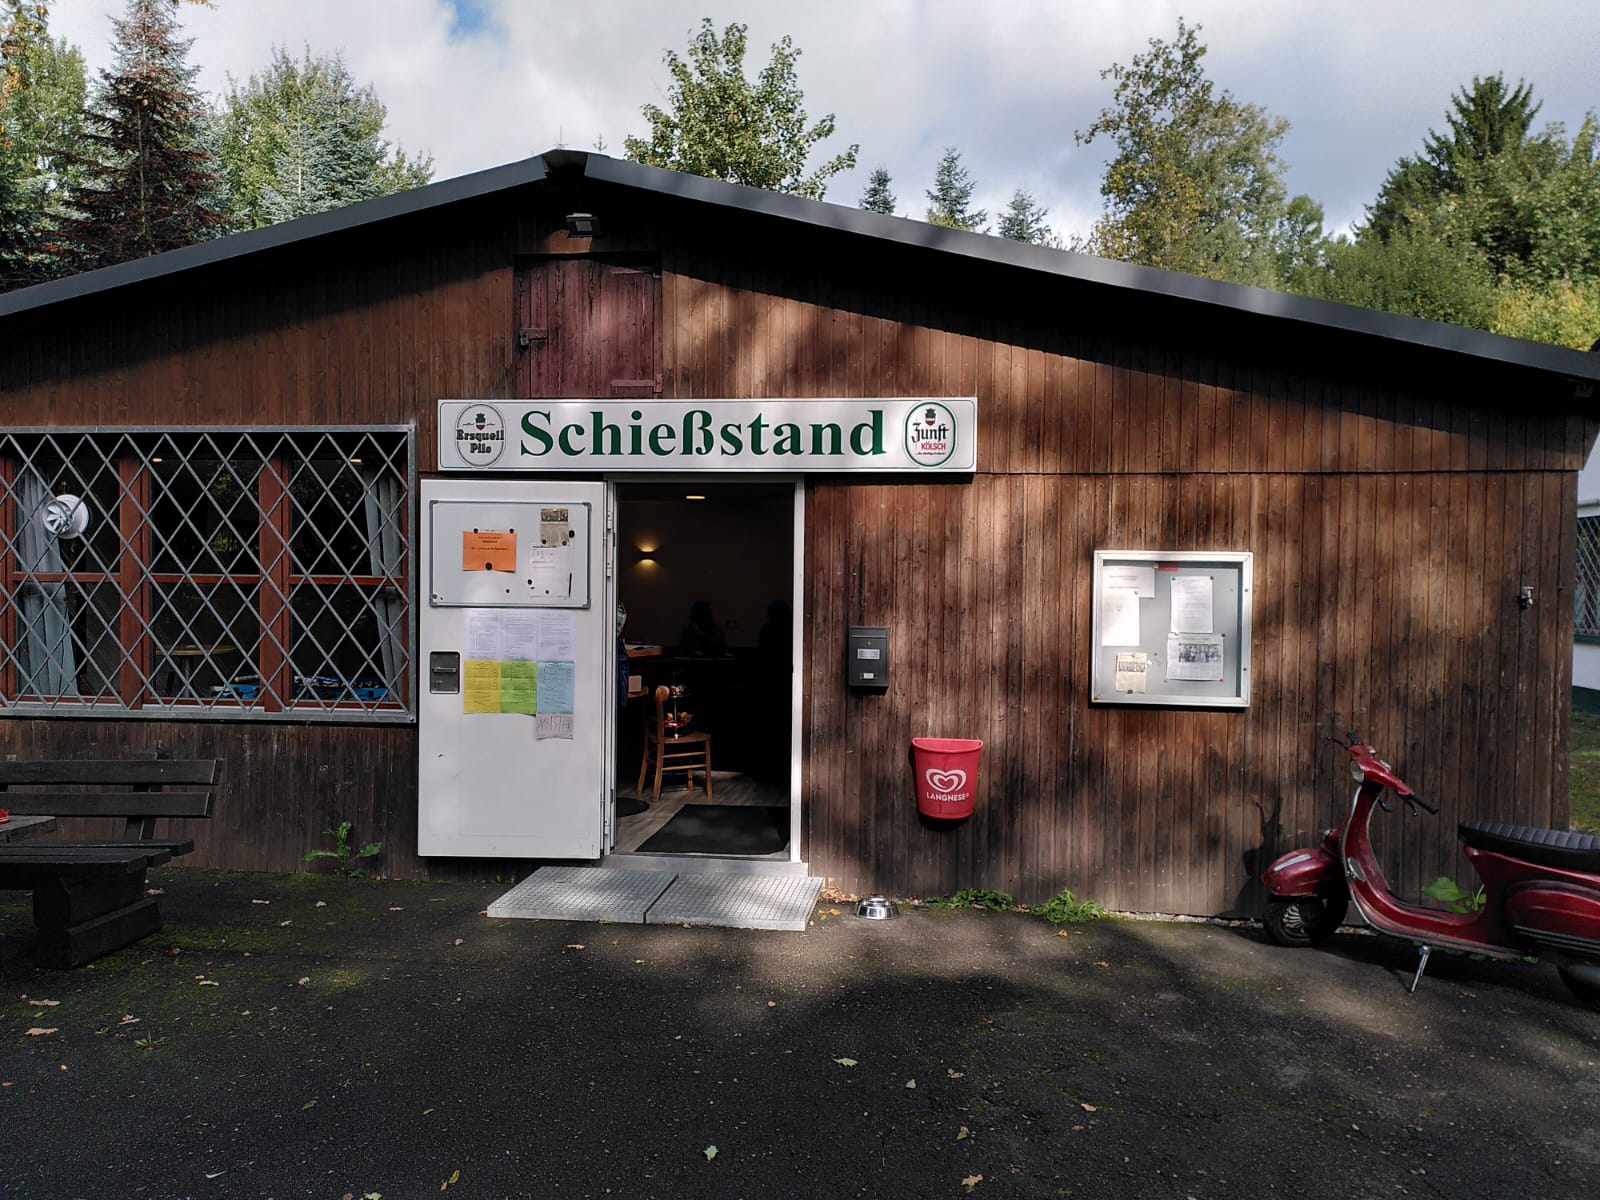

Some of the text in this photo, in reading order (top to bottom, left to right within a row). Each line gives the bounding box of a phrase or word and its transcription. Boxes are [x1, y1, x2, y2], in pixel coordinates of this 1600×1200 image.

[520, 409, 886, 456] Schießstand
[911, 422, 949, 443] Zunft
[920, 441, 946, 451] KÖLSCH
[926, 791, 967, 802] LANGNESE
